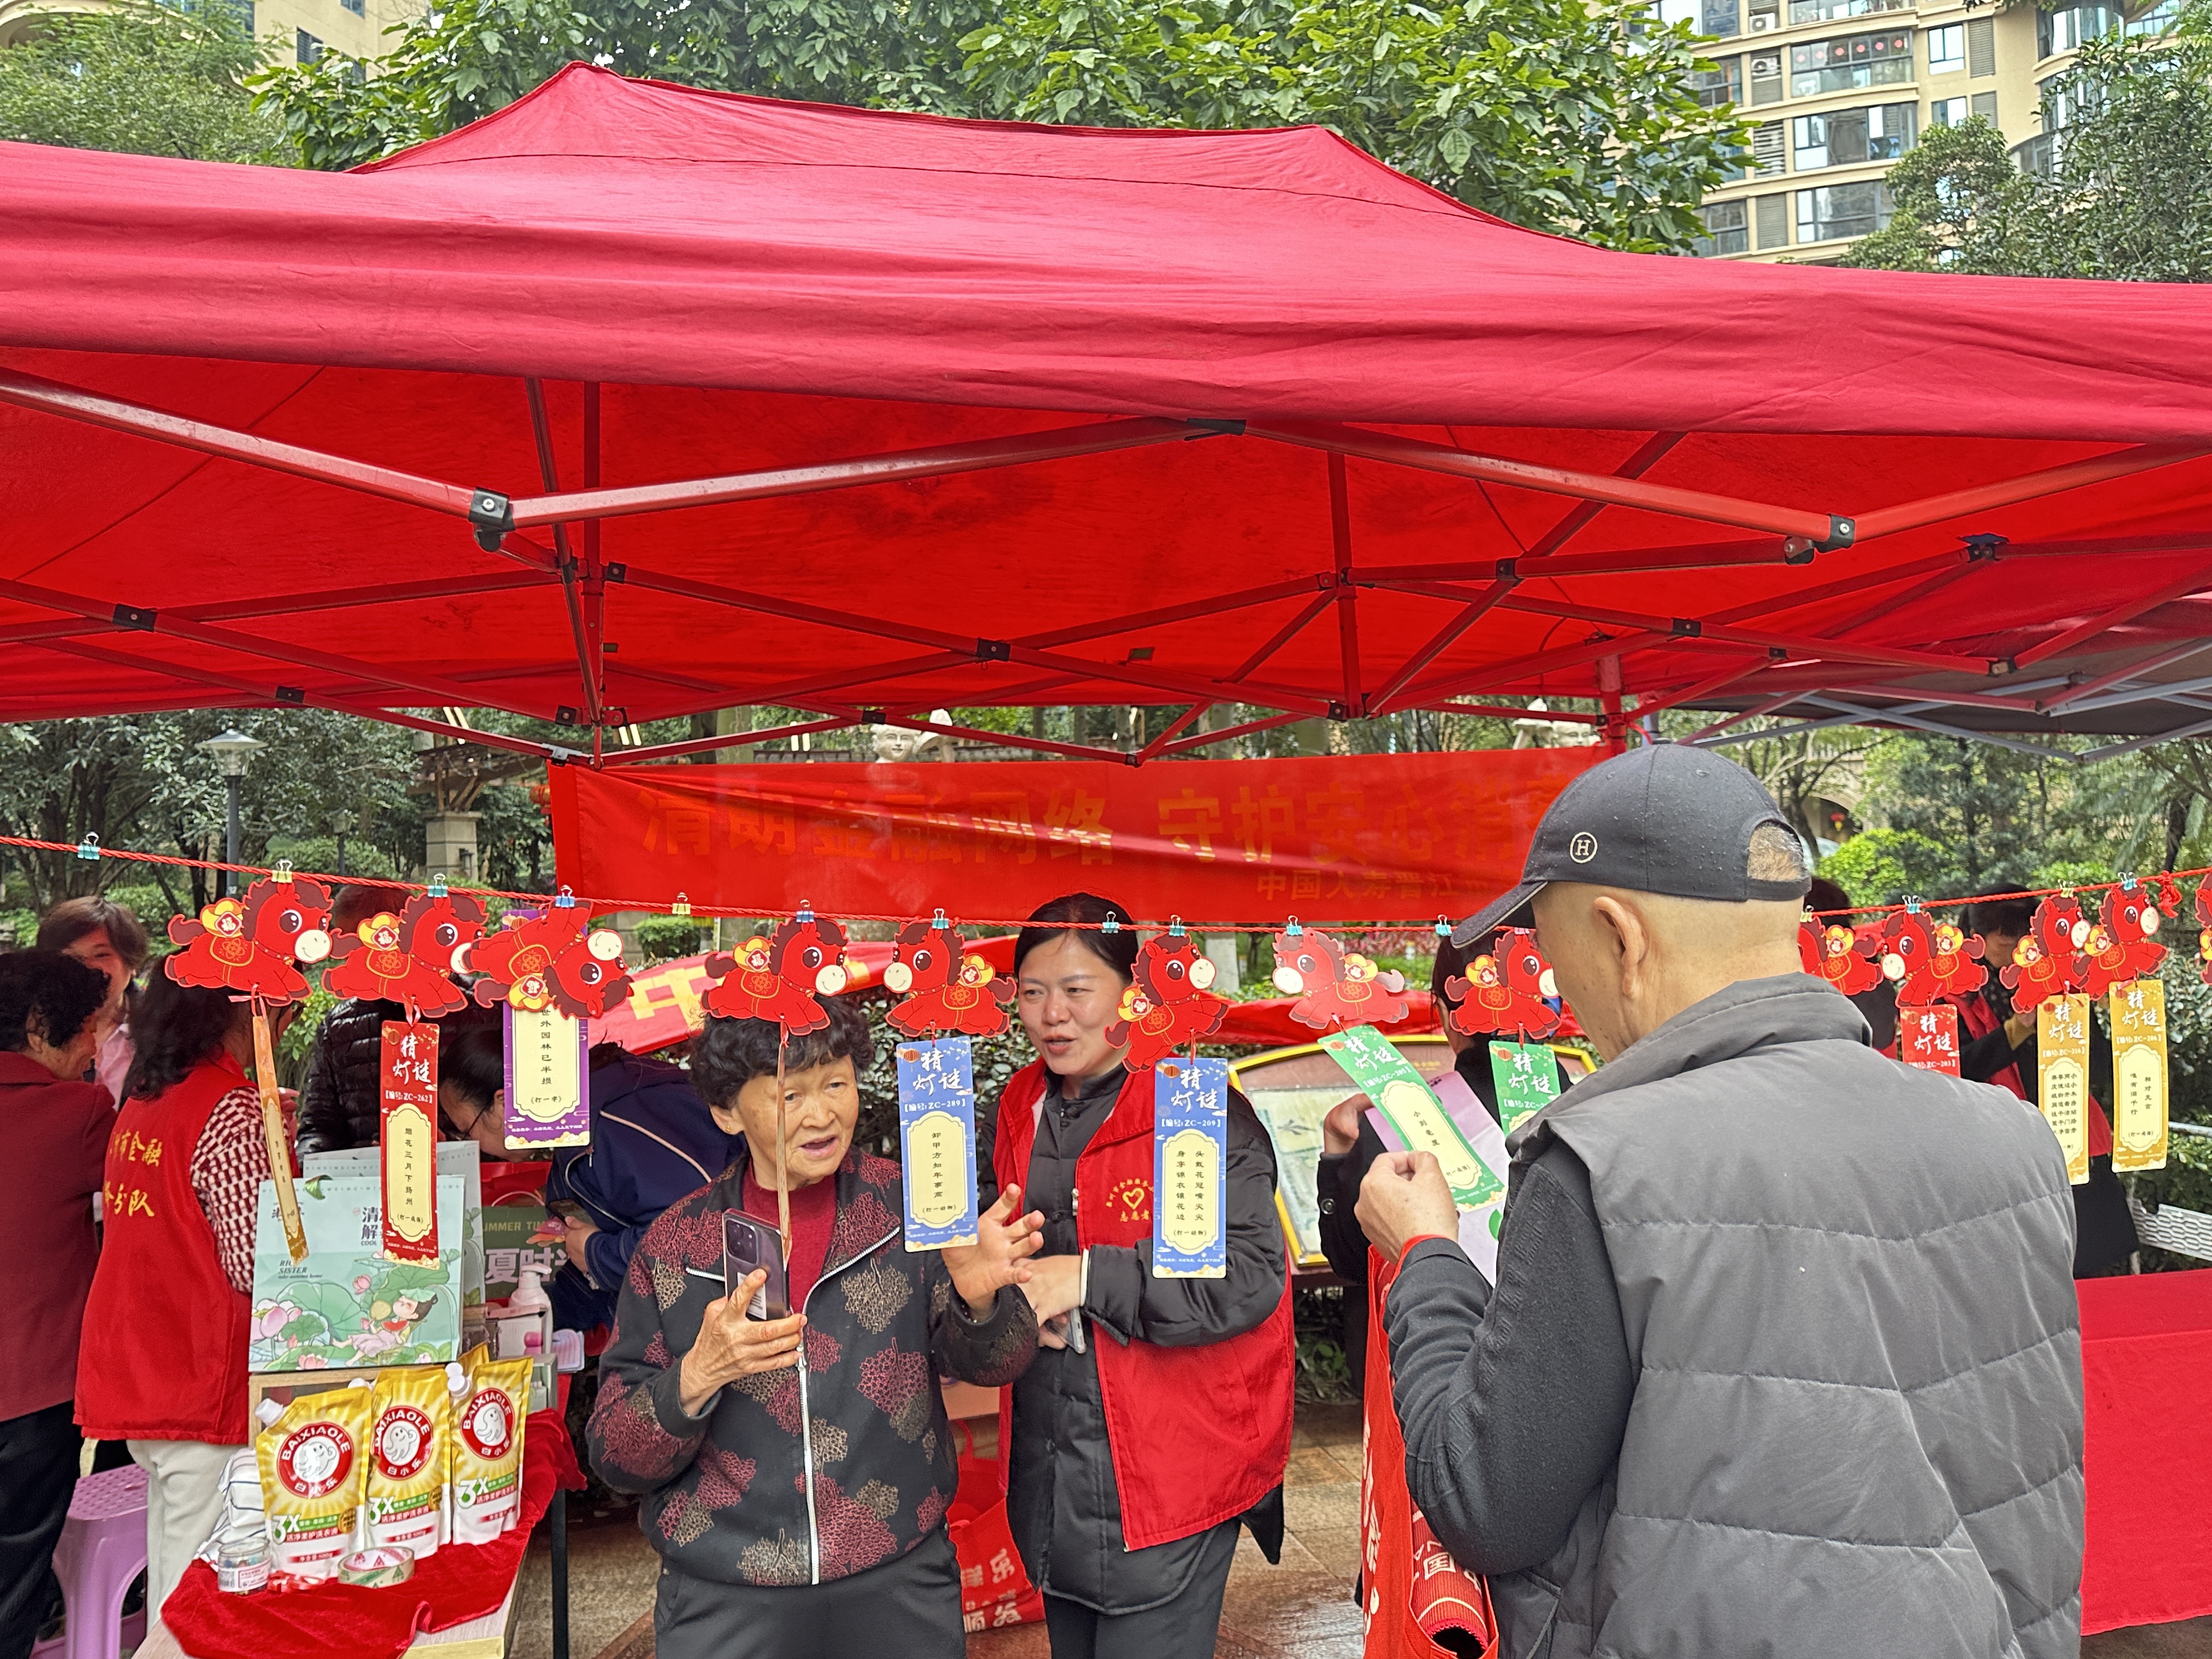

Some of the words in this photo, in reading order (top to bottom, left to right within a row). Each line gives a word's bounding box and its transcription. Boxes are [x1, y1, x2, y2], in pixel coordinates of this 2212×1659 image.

[637, 783, 1114, 865] 清朗金融网络
[1575, 840, 1590, 855] H
[2128, 990, 2145, 1010] 猜
[1920, 1013, 1938, 1035] 猜
[2055, 1002, 2073, 1023] 猜
[2121, 1007, 2160, 1031] 灯谜
[1914, 1031, 1954, 1056] 灯谜
[2048, 1021, 2085, 1043] 灯谜
[400, 1032, 418, 1059] 猜
[1344, 1035, 1370, 1054] 猜
[921, 1050, 944, 1072] 猜
[1354, 1046, 1398, 1071] 灯谜
[1513, 1051, 1534, 1074] 猜
[392, 1059, 431, 1085] 灯谜
[912, 1068, 964, 1096] 灯谜
[1181, 1066, 1203, 1090] 猜
[1508, 1073, 1554, 1095] 灯谜
[1171, 1088, 1220, 1113] 灯谜
[2130, 1073, 2138, 1115] 唯有泪千行
[404, 1127, 413, 1206] 烟花三月下扬州
[932, 1132, 944, 1198] 卸甲方知年事高
[1446, 1164, 1471, 1176] 打一成语)
[1195, 1150, 1204, 1221] 头戴花冠嘴尖尖
[362, 1206, 382, 1223] 清
[361, 1224, 382, 1239] 解
[463, 1392, 511, 1429] BAIXIAOLE
[281, 1426, 351, 1460] BAIXIAOLE
[387, 1458, 422, 1476] 白小乐
[294, 1477, 338, 1494] 白小乐
[456, 1476, 489, 1509] 3X
[369, 1496, 394, 1525] 3X
[272, 1514, 301, 1544] 3X
